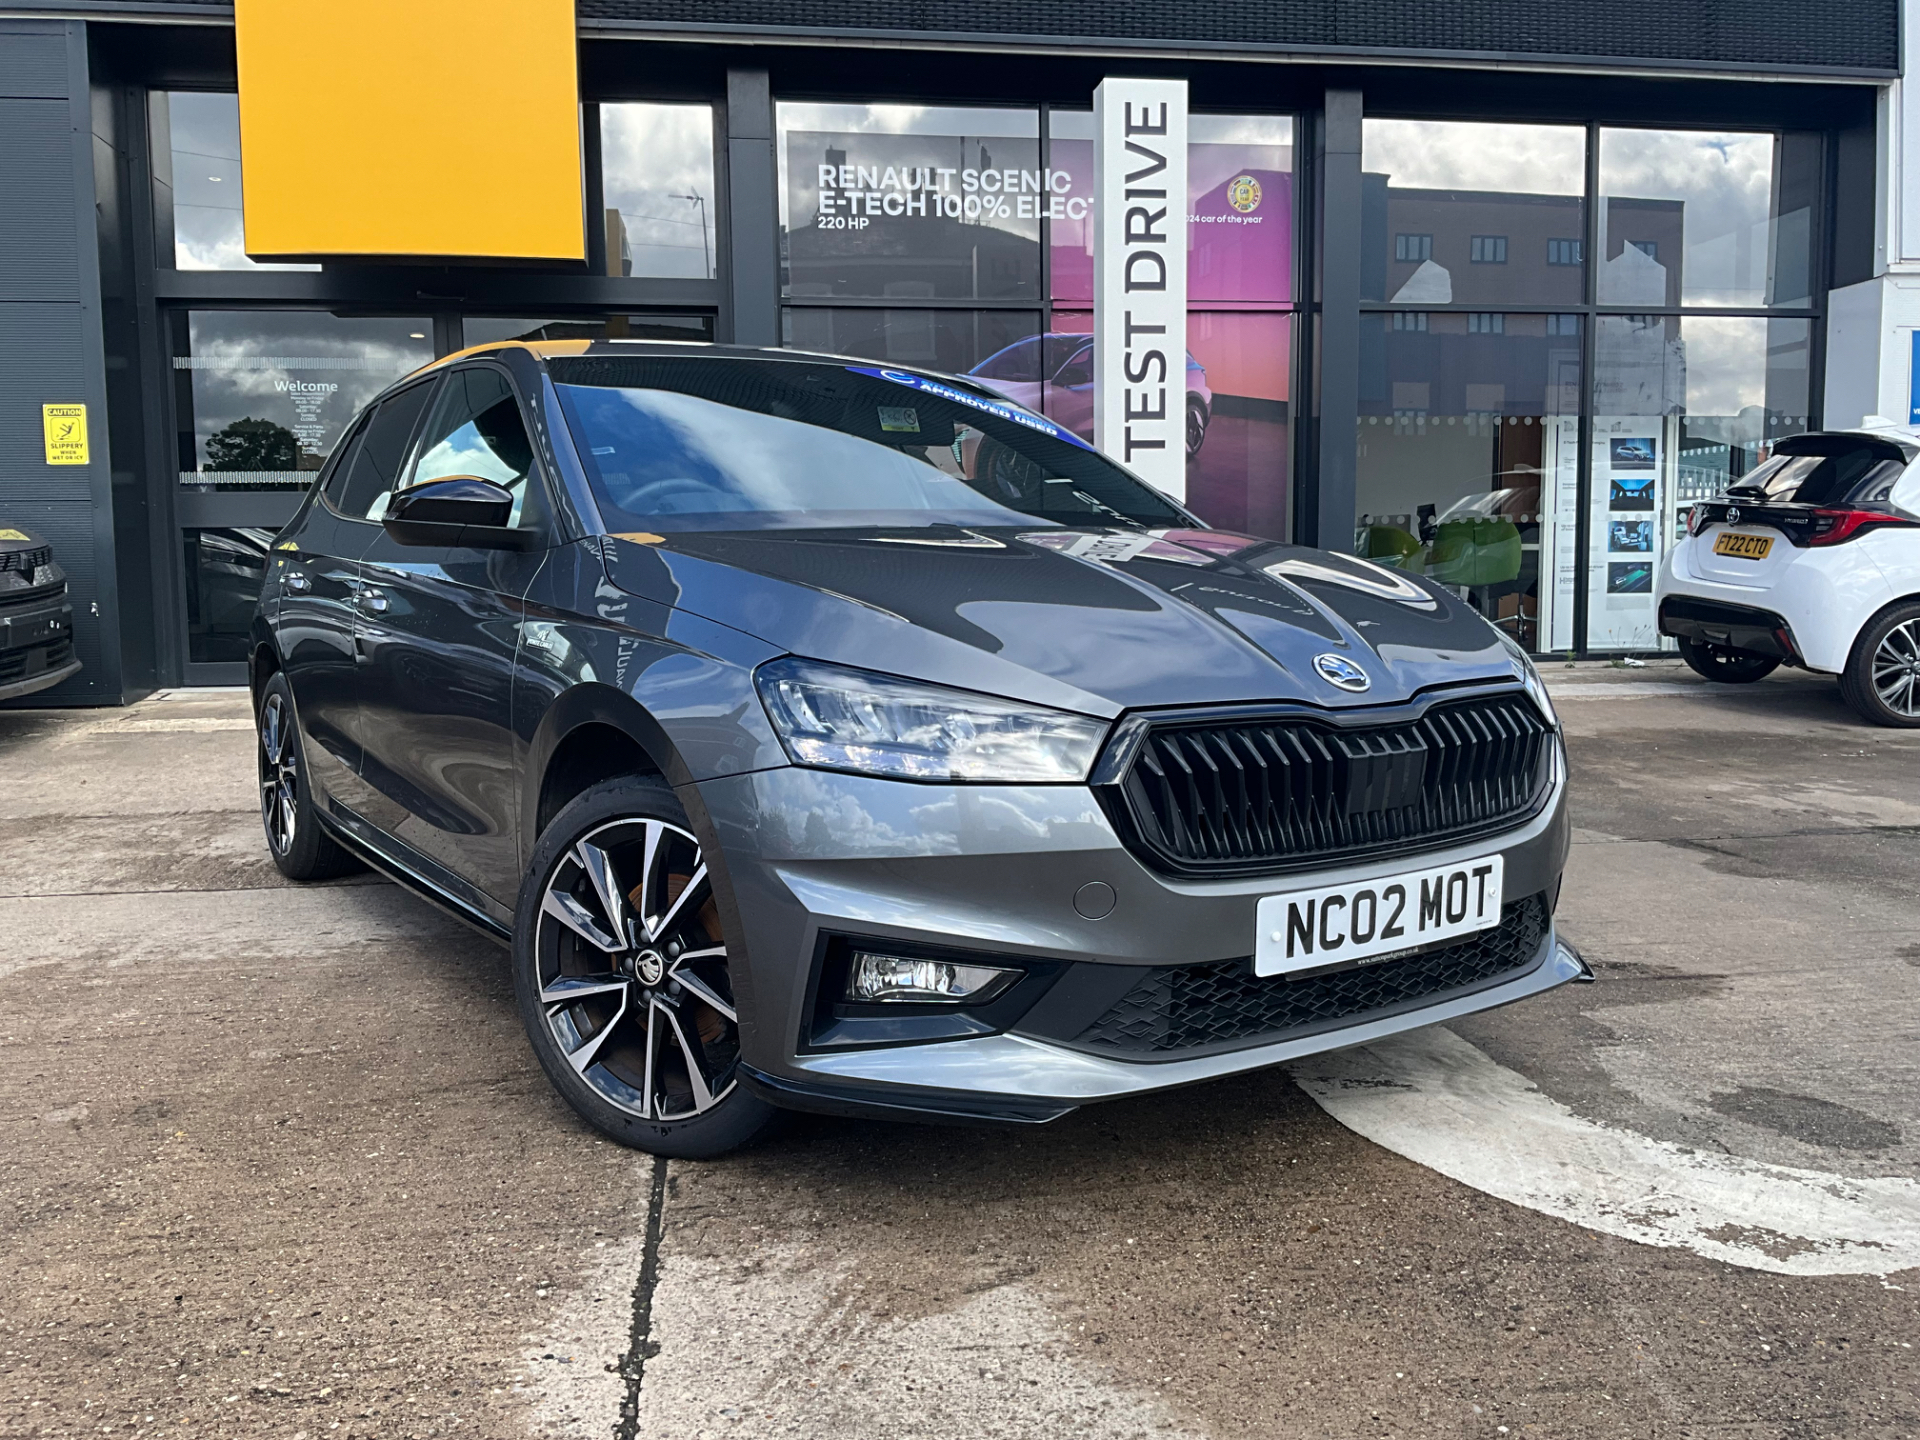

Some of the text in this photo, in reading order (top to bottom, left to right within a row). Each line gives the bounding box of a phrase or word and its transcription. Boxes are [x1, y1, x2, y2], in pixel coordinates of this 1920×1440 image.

[818, 164, 1072, 194] RENAULT SCENIC
[819, 190, 1094, 220] E-TECH 100% ELEC
[817, 216, 870, 230] 220 HP
[1201, 215, 1216, 223] car
[1216, 214, 1227, 223] of
[1227, 214, 1242, 223] the
[1242, 216, 1263, 225] year
[1124, 101, 1167, 463] TEST DRIVE
[274, 380, 338, 392] Welcome
[47, 408, 82, 416] CAUTION
[920, 384, 1011, 418] APPROVED
[1014, 415, 1058, 436] USED
[1716, 533, 1769, 555] FT22 CTO
[1286, 864, 1492, 959] NC02 MOT
